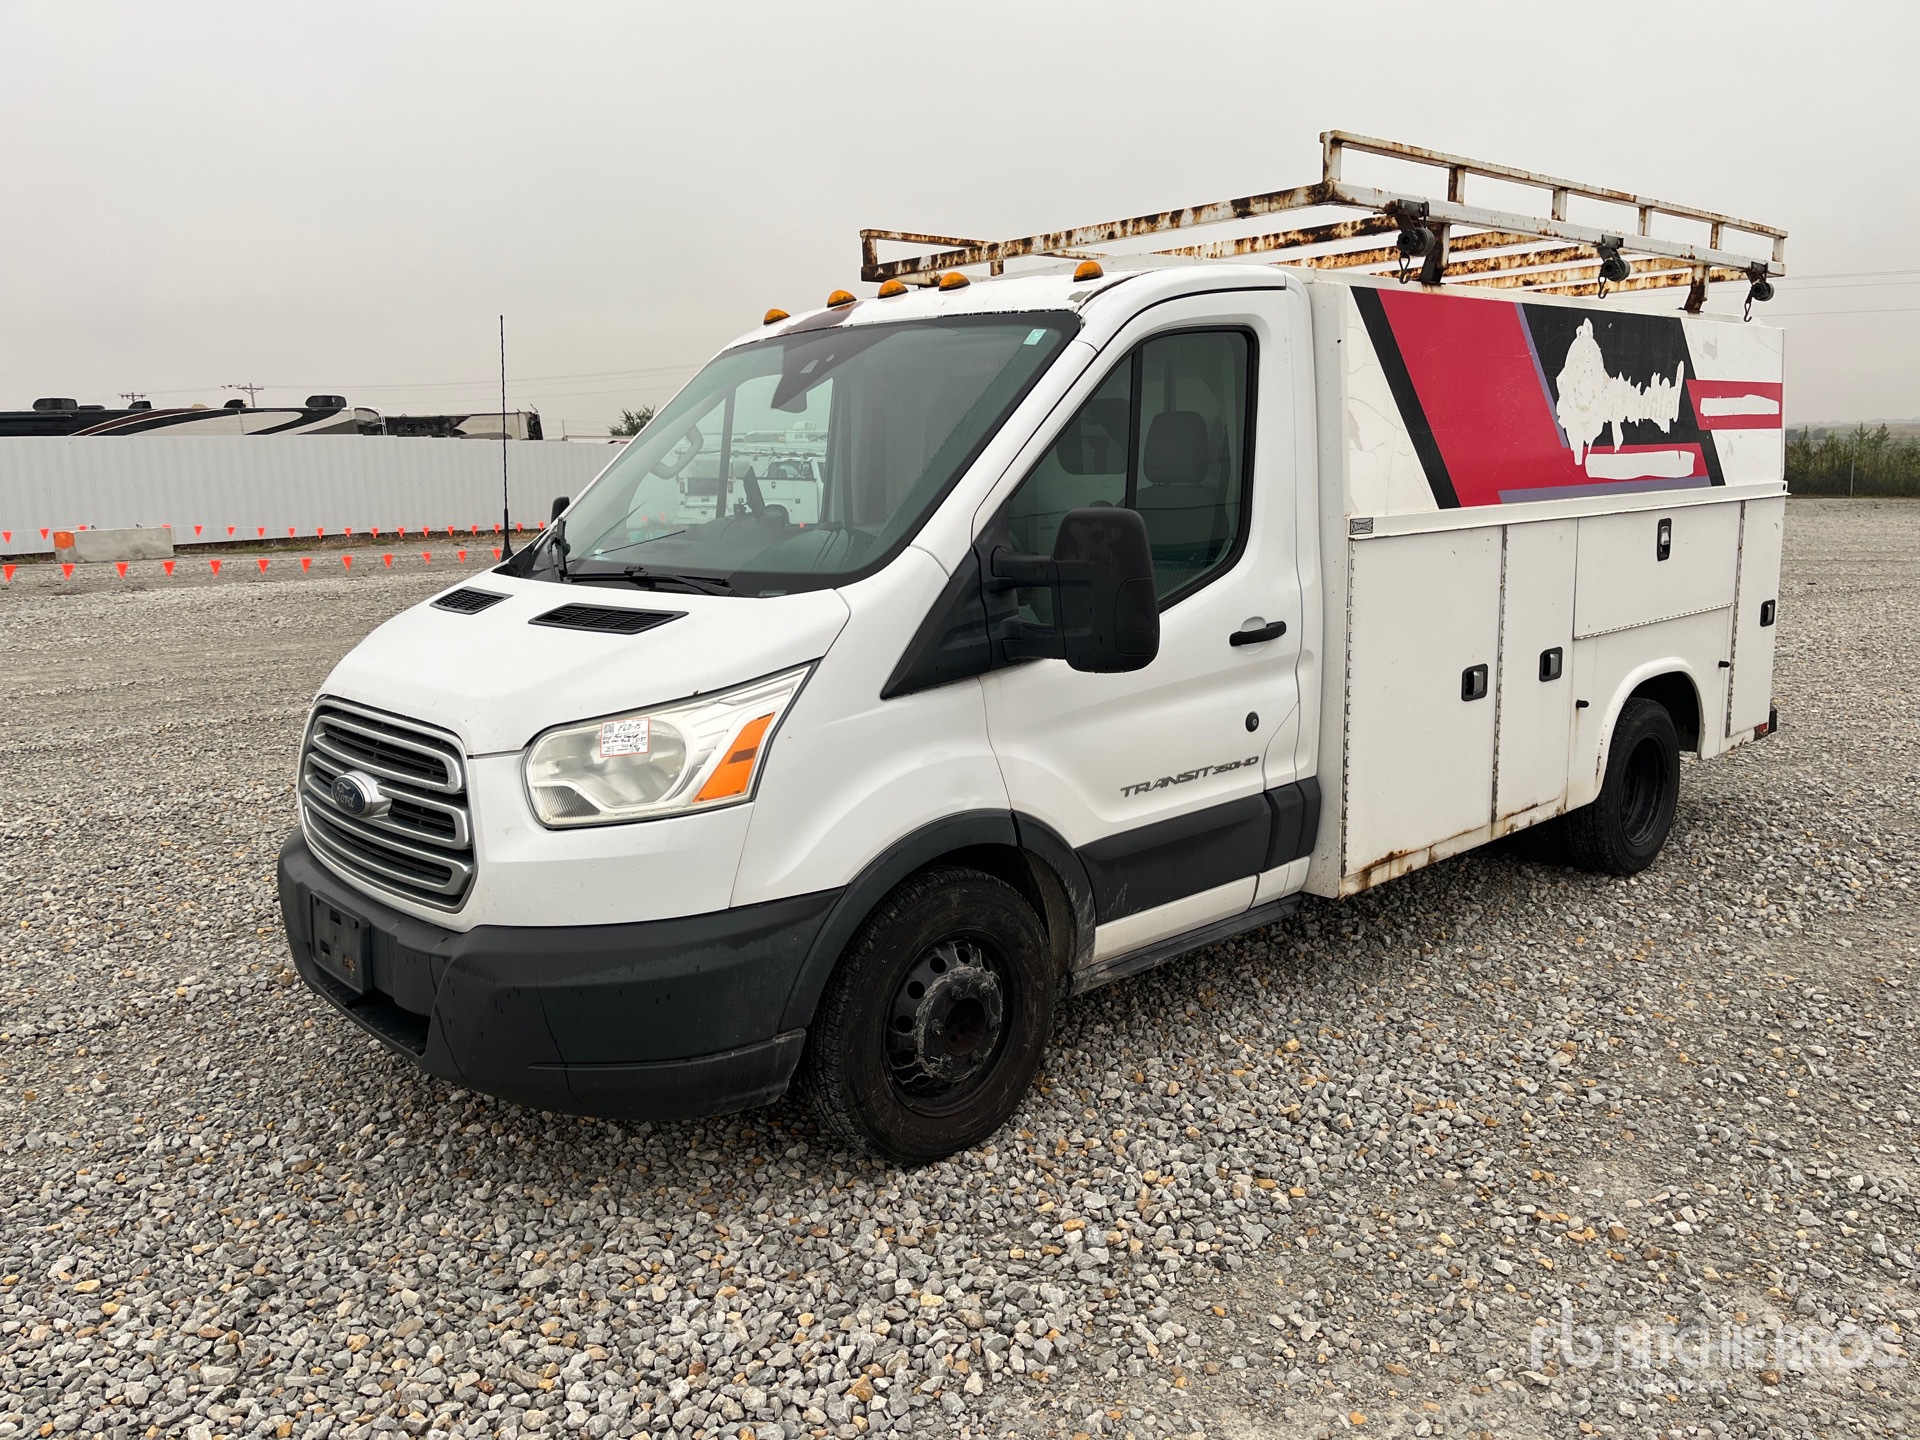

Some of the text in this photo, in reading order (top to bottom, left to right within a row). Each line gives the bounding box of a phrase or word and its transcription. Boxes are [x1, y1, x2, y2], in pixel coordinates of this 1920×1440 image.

[1120, 755, 1260, 797] TRANSIT 350HD
[334, 782, 356, 808] Ford
